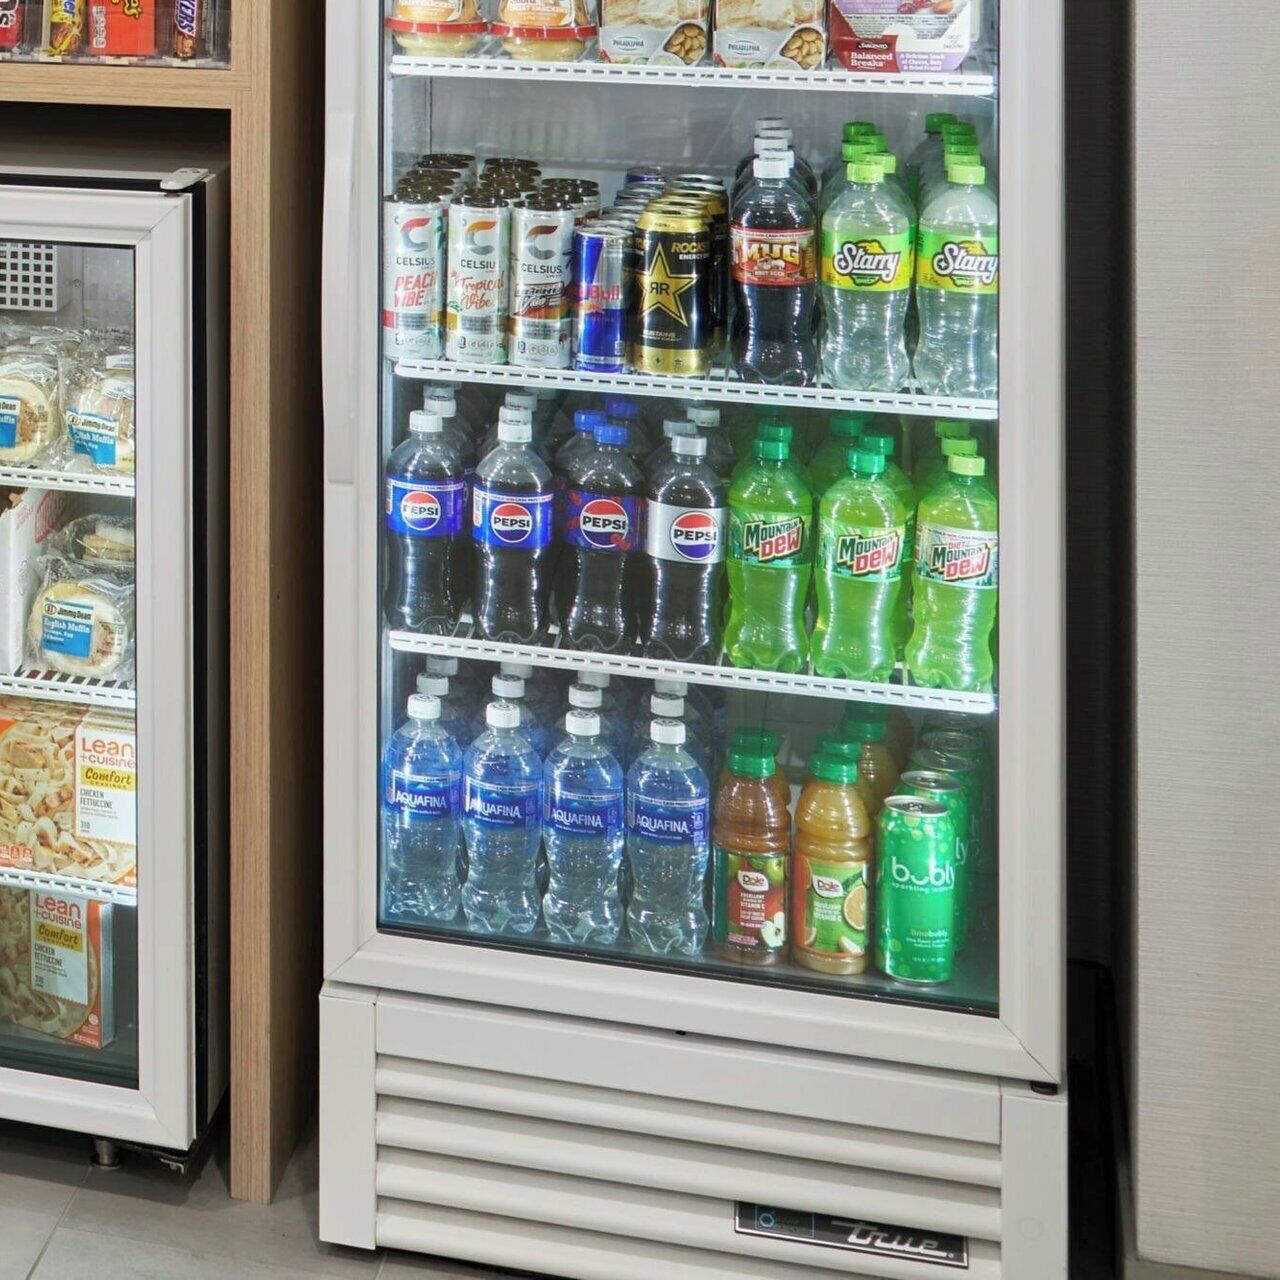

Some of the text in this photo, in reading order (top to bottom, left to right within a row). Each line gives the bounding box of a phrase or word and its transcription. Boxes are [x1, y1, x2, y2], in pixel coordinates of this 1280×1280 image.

[612, 40, 644, 48] PHILADELPHIA
[728, 44, 760, 52] PHILADELPHIA
[850, 52, 893, 61] Balanced
[396, 256, 436, 266] CELSIUS
[743, 242, 800, 265] MUG
[521, 263, 562, 274] CELSIUS
[834, 241, 901, 282] Starry
[934, 242, 998, 284] Starry
[395, 272, 437, 290] PEACH
[461, 271, 504, 293] Tropical
[394, 290, 424, 308] VIBE
[590, 284, 620, 300] Bull
[460, 294, 492, 310] Vibe
[1, 402, 17, 410] Dean
[403, 504, 440, 517] PEPSI
[493, 516, 532, 529] PEPSI
[582, 516, 627, 531] PEPSI
[674, 529, 717, 542] PEPSI
[948, 540, 966, 550] DIET
[57, 606, 92, 620] Jimmy Dean
[44, 618, 90, 634] English Muffin
[82, 738, 134, 758] Lean
[85, 768, 132, 785] Comfort
[80, 788, 104, 798] CHICKEN
[396, 791, 447, 809] AQUAFINA
[80, 797, 113, 809] FETTUCCINE
[470, 798, 521, 818] AQUAFINA
[552, 808, 602, 827] AQUAFINA
[636, 814, 690, 834] AQUAFINA
[742, 874, 765, 886] Dole
[891, 856, 955, 889] bubly
[816, 879, 840, 891] Dole
[36, 893, 81, 920] Lean
[38, 923, 79, 945] Comfort
[34, 942, 56, 956] CHICKEN
[34, 952, 63, 967] FETTUCCINE
